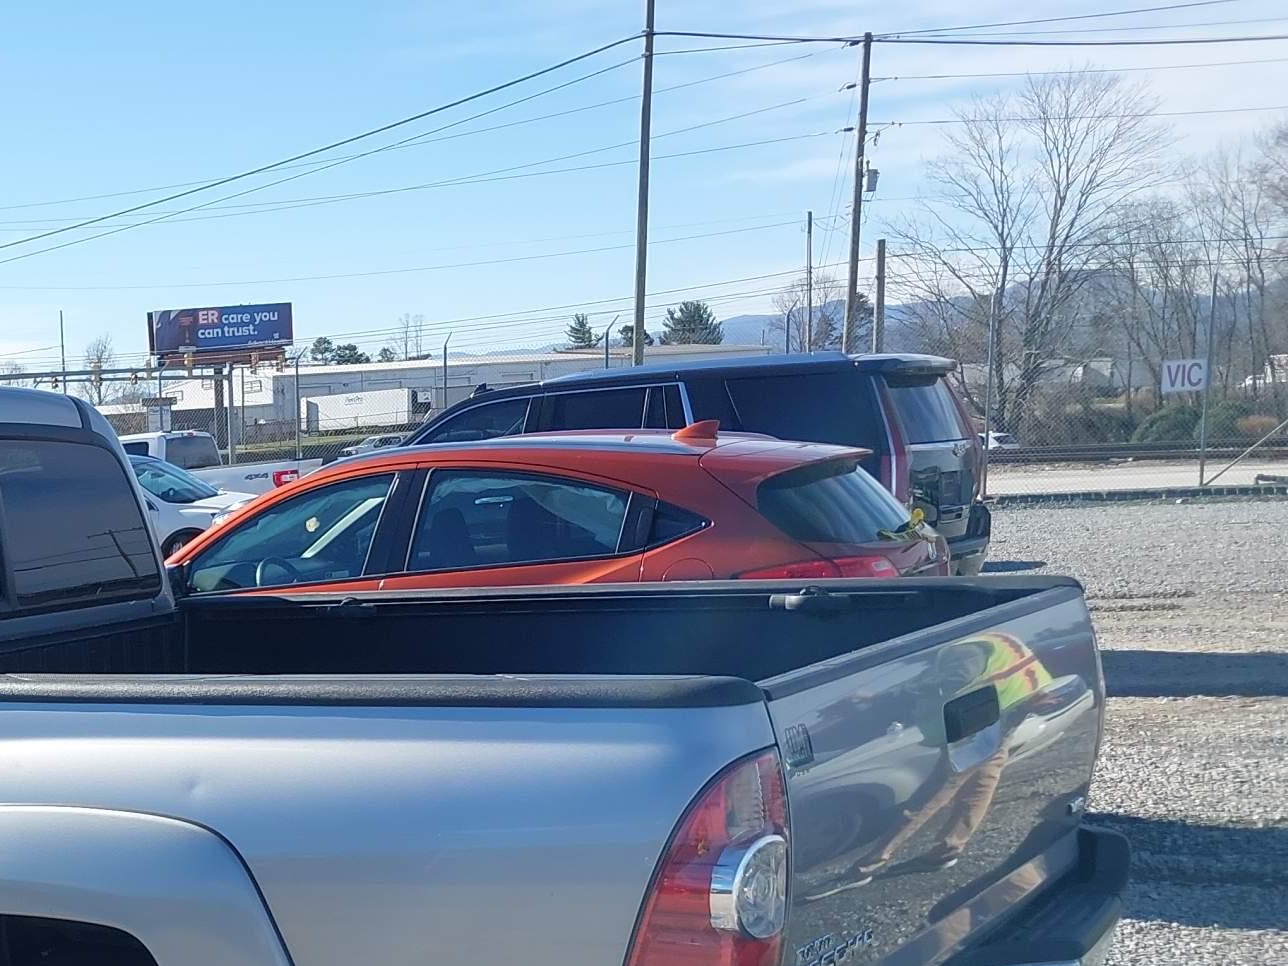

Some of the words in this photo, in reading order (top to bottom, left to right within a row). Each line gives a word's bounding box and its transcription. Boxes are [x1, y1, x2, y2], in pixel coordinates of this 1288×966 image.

[198, 310, 219, 324] ER
[221, 314, 251, 324] care
[254, 311, 279, 325] you
[198, 327, 222, 339] can
[224, 325, 258, 338] trust.
[1167, 362, 1203, 388] VIC
